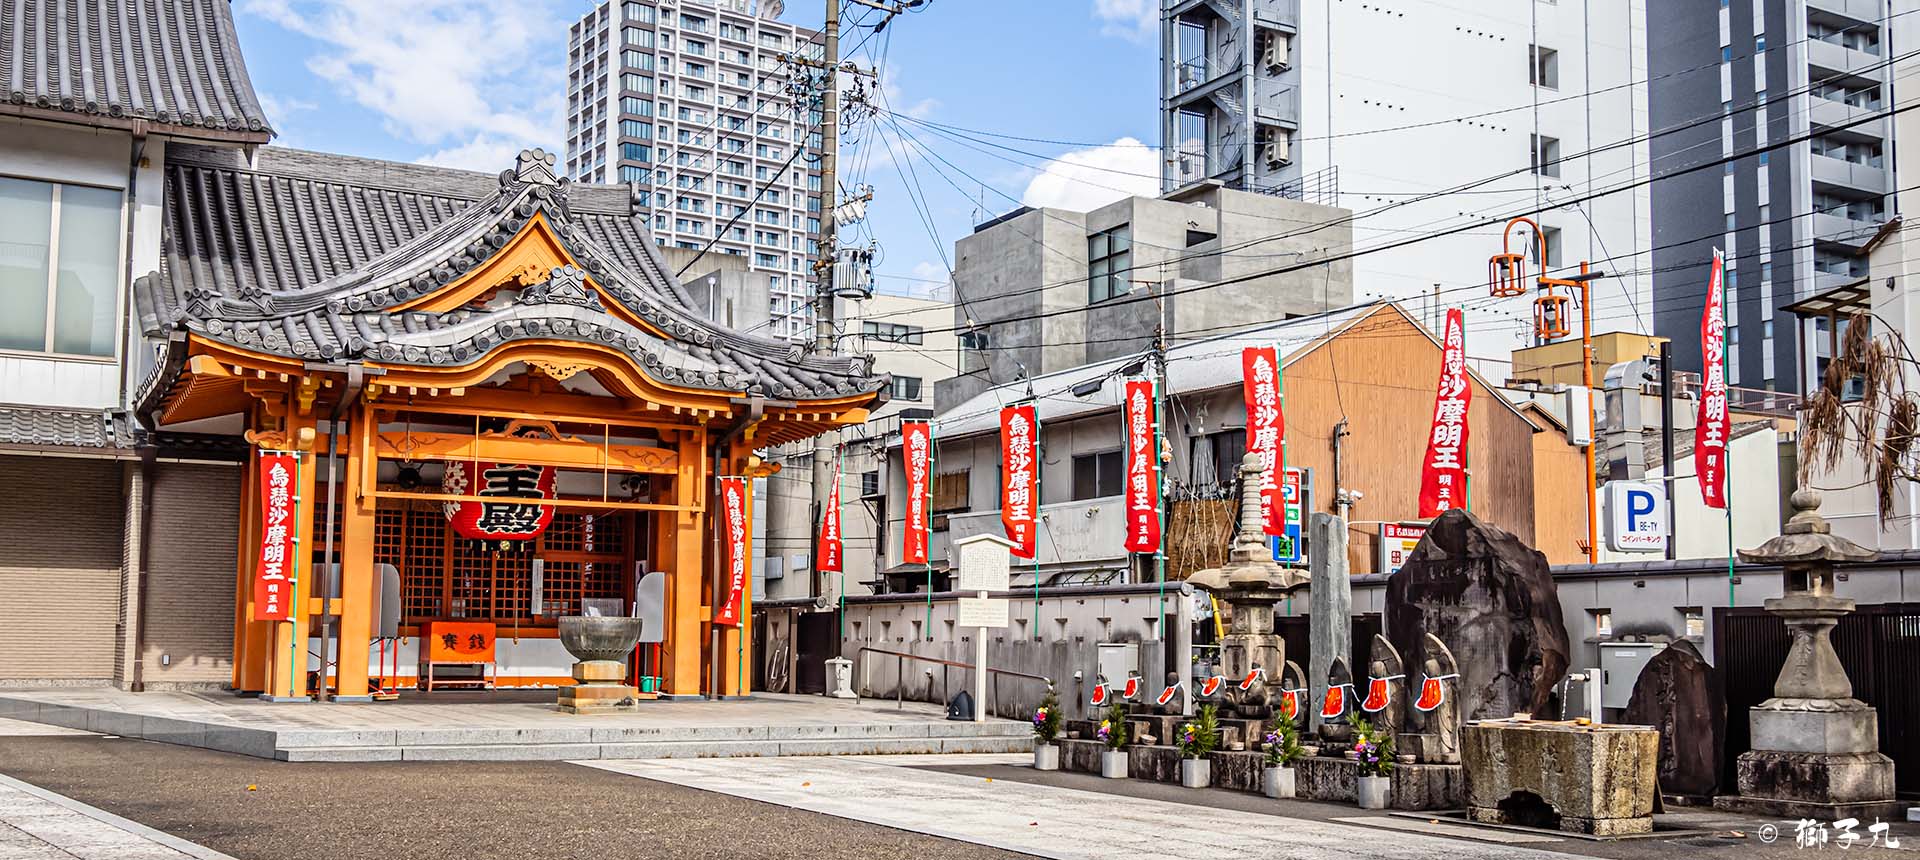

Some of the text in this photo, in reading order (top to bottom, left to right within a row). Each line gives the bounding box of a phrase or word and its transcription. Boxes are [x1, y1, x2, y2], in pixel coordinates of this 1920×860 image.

[476, 462, 545, 534] 王殿
[1627, 490, 1655, 532] P
[263, 463, 290, 581] 烏瑟沙摩明王
[1622, 535, 1662, 544] コインパーキング
[1639, 521, 1658, 532] BE-TY
